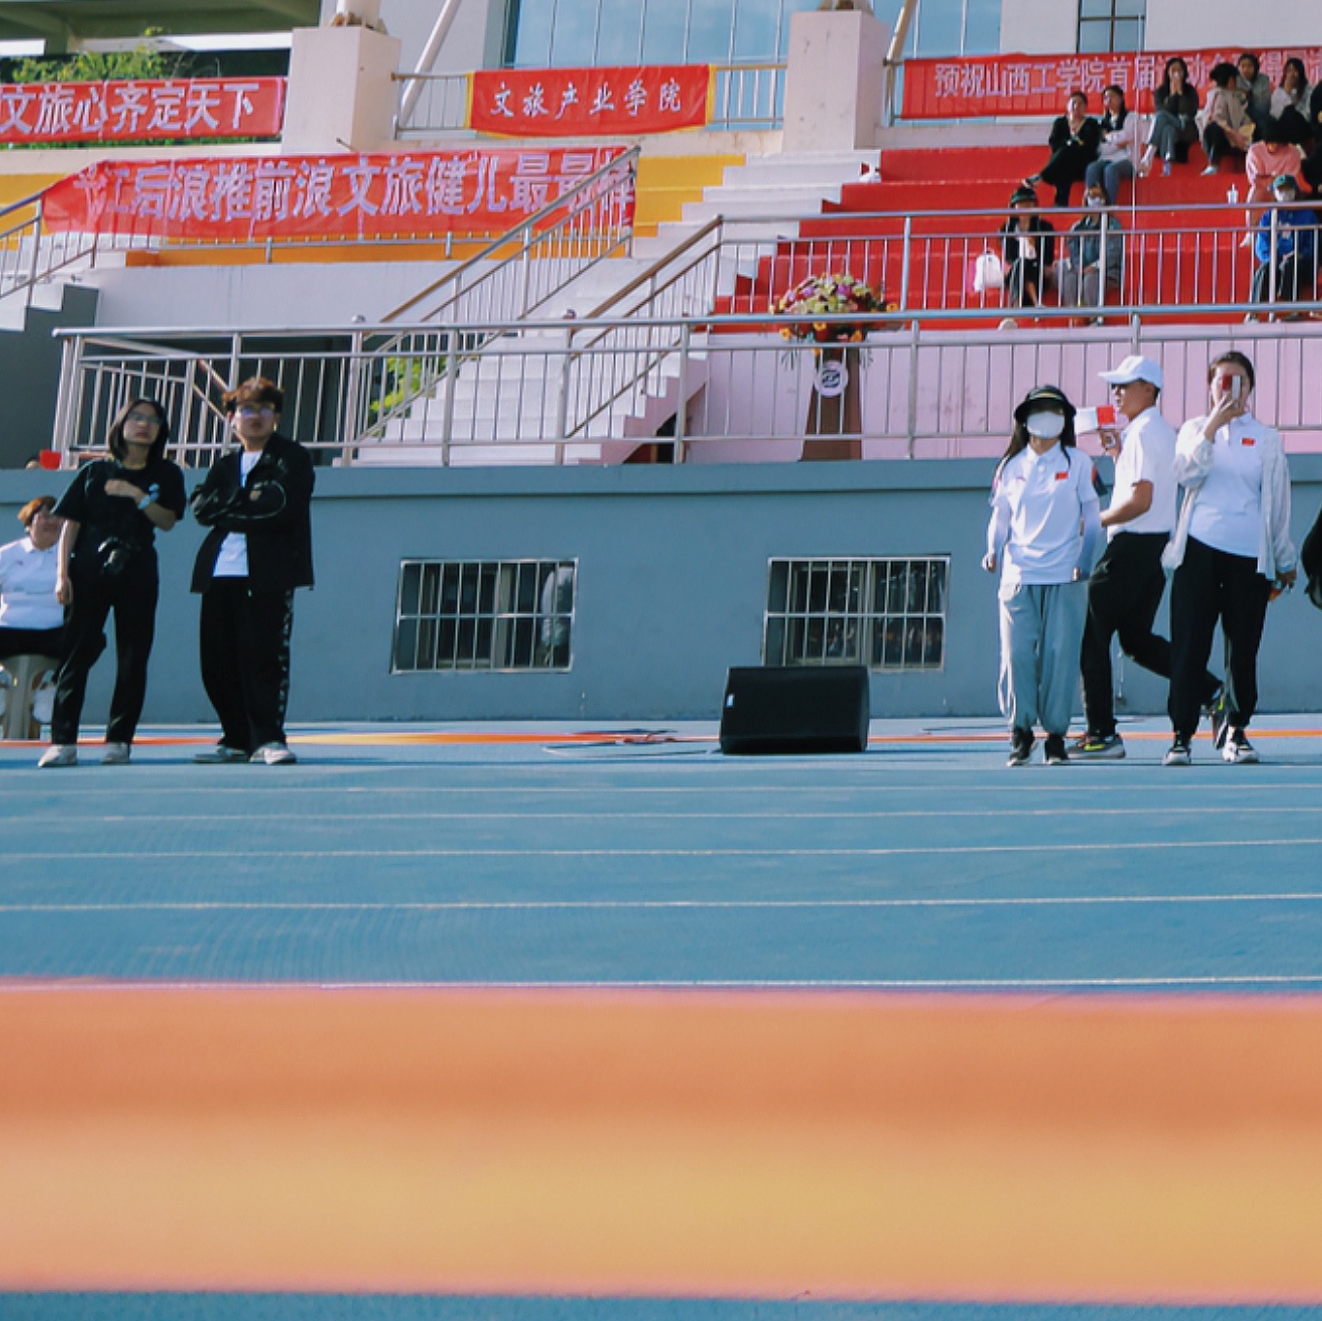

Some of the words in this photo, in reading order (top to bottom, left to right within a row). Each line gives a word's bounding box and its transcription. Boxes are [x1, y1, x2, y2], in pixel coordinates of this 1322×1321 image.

[0, 81, 260, 135] 文旅心齐定天下
[490, 77, 682, 120] 文旅产业学院
